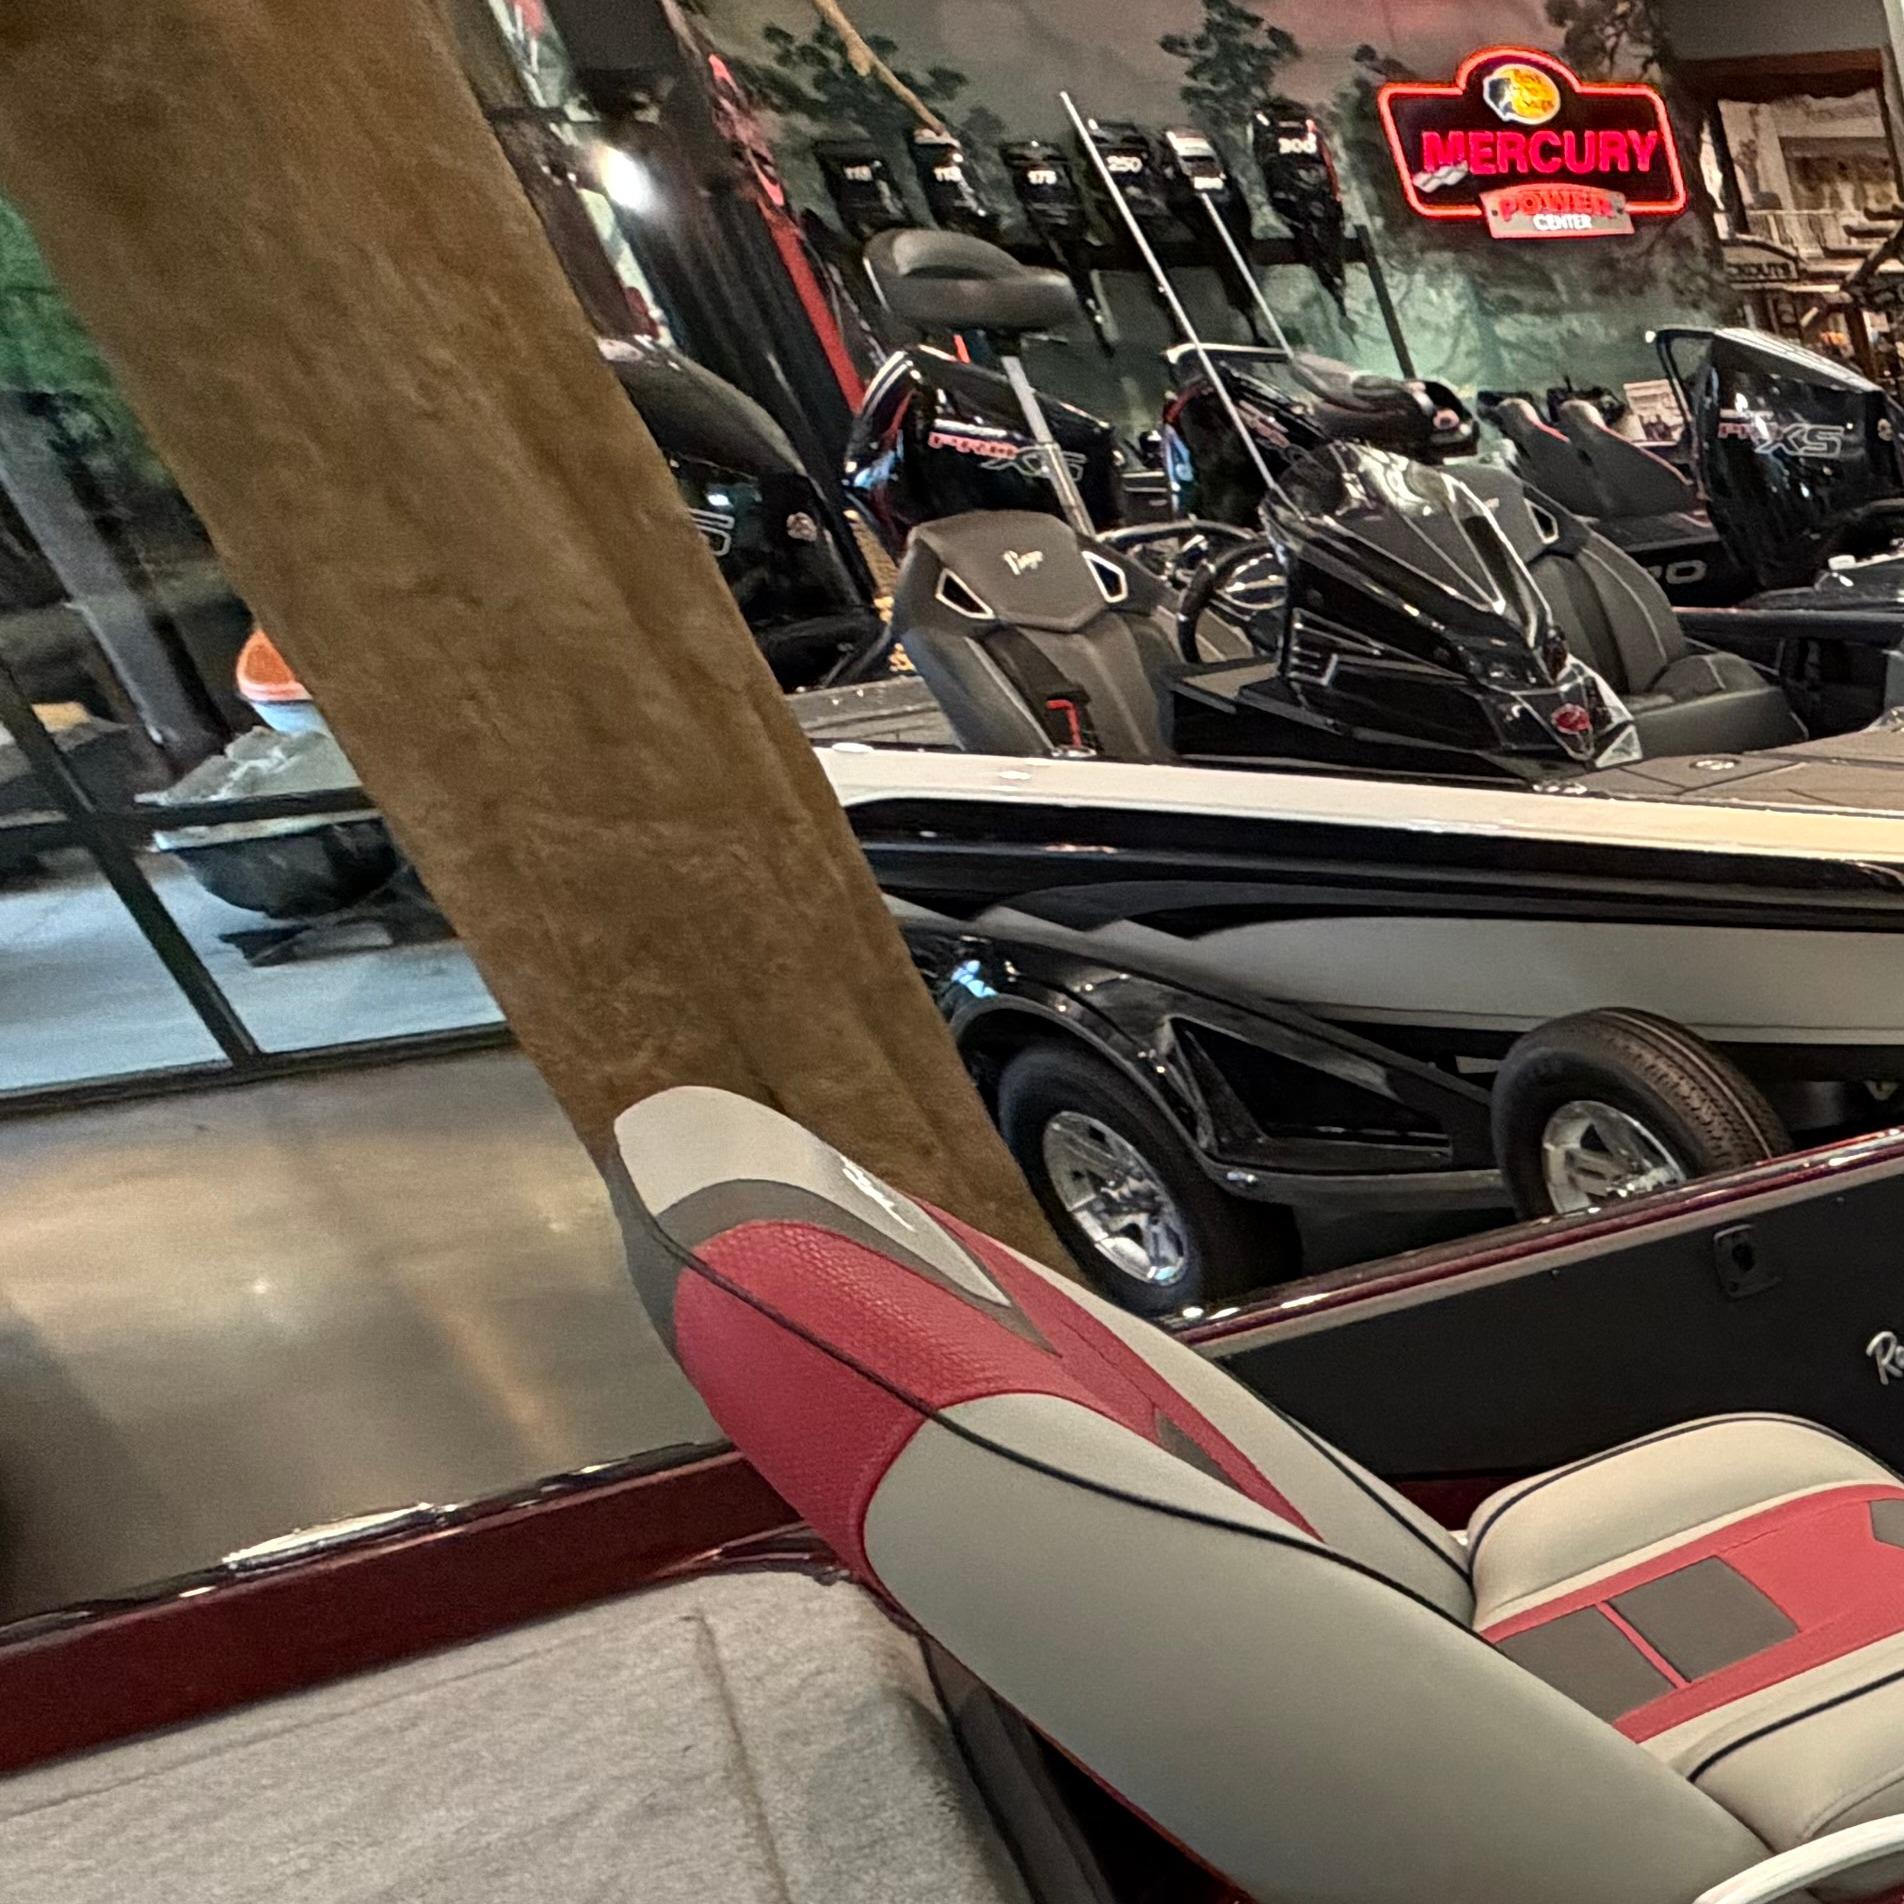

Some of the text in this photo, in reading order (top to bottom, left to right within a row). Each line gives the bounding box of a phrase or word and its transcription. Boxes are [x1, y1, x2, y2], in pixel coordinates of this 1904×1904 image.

[1420, 130, 1658, 176] MERCURY
[1500, 189, 1614, 222] POWER
[1532, 213, 1592, 231] CENTER
